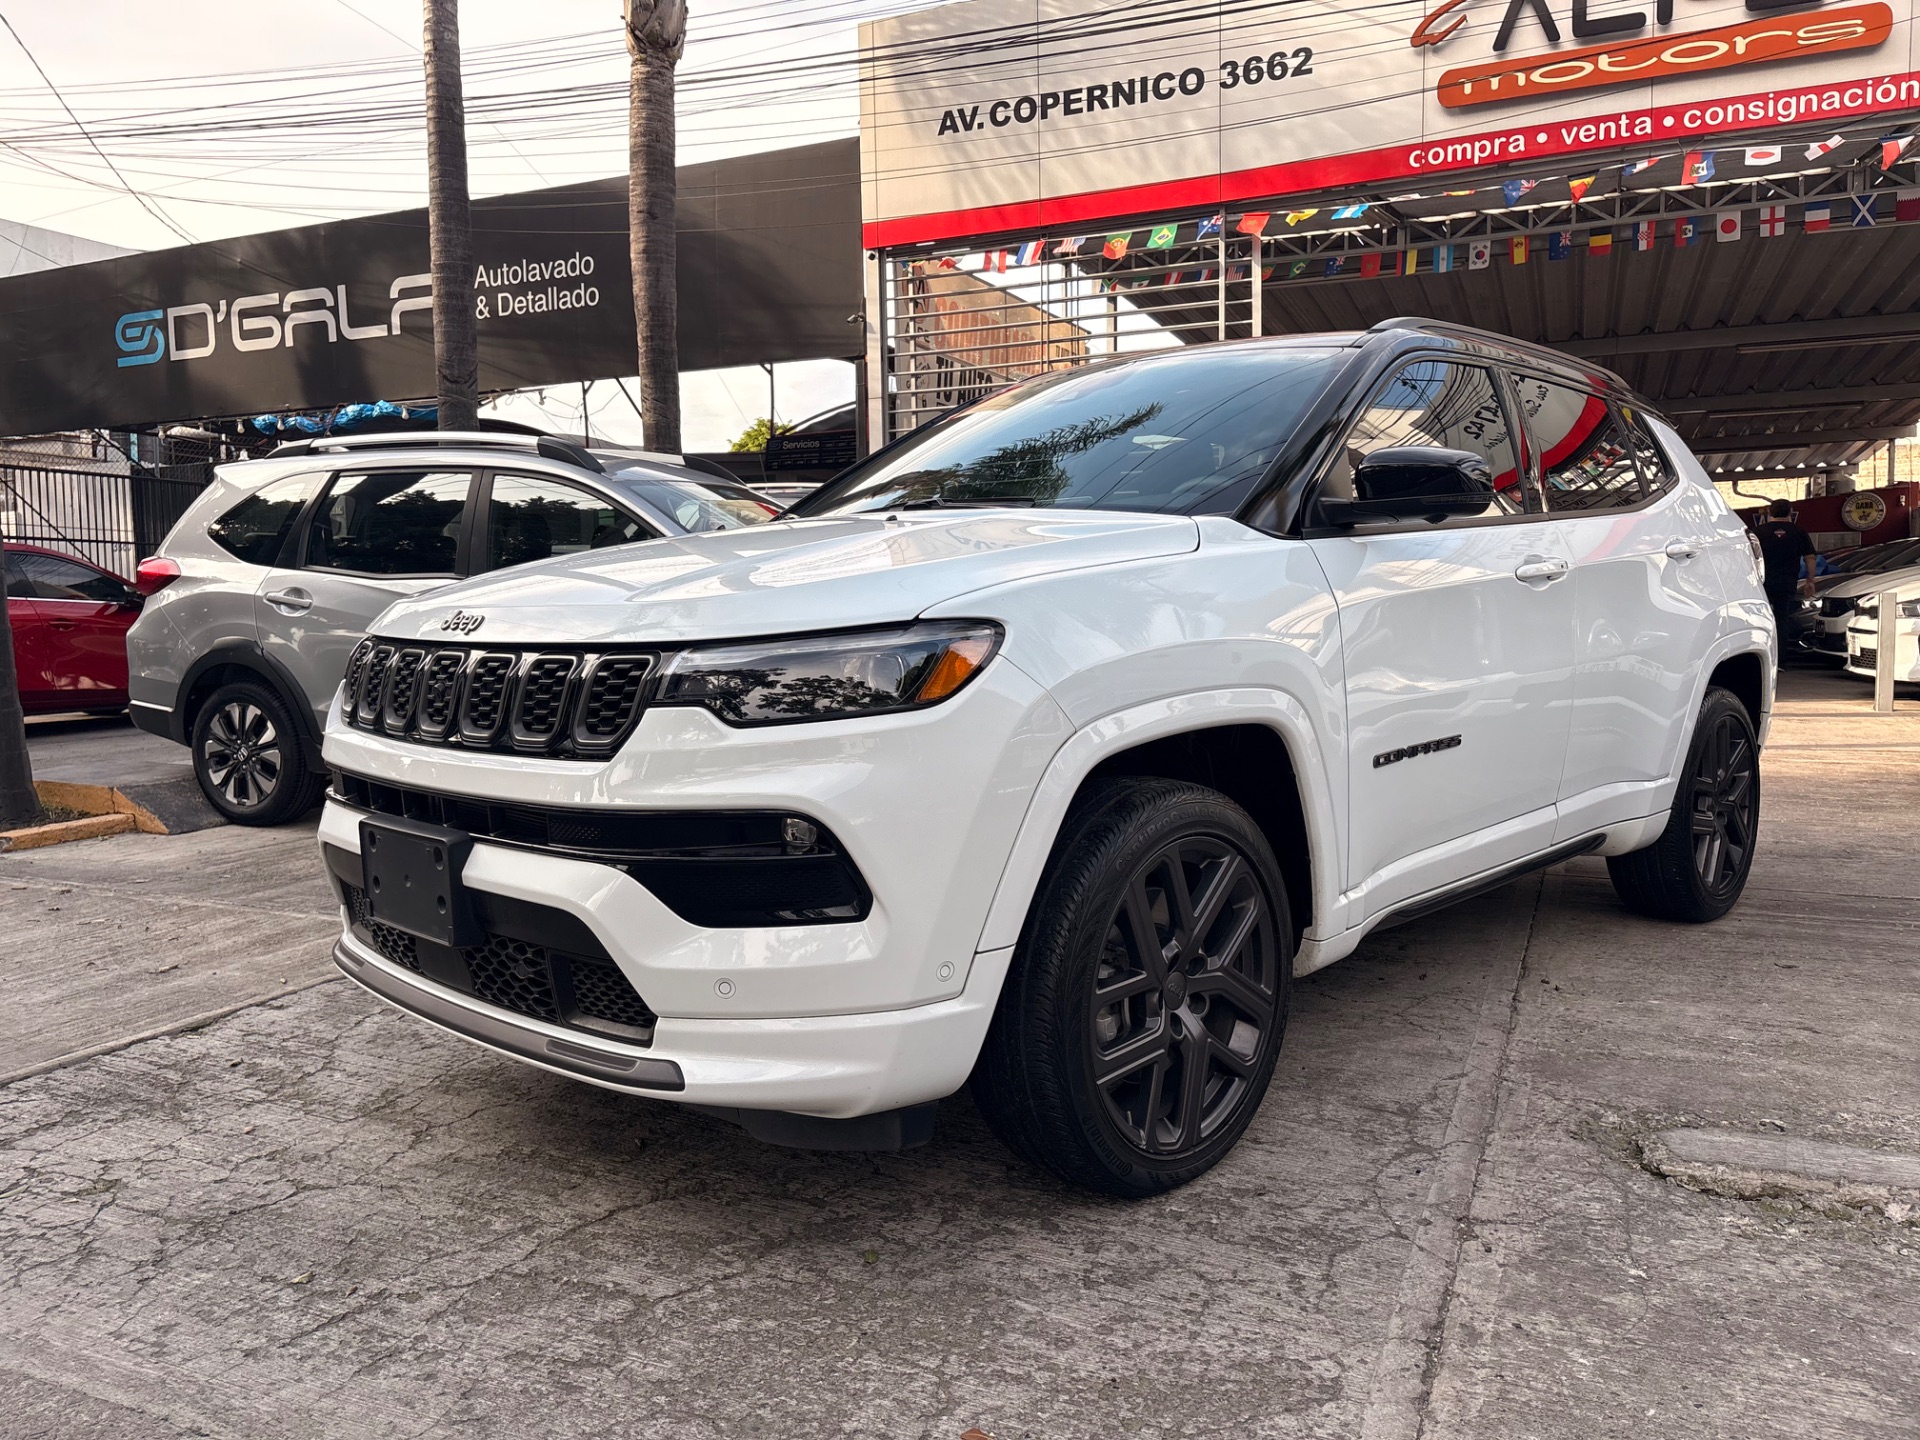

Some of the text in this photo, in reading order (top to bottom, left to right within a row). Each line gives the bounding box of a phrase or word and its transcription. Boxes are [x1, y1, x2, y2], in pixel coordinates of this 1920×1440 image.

[1493, 0, 1823, 51] AL
[1219, 46, 1315, 90] 3662
[1457, 18, 1867, 96] motors
[1408, 76, 1920, 170] compra venta consignación
[473, 251, 595, 288] Autolavado
[475, 281, 601, 319] & Detallado
[782, 439, 820, 450] Servicios
[441, 610, 486, 636] Jeep
[1373, 734, 1462, 769] COMPASS
